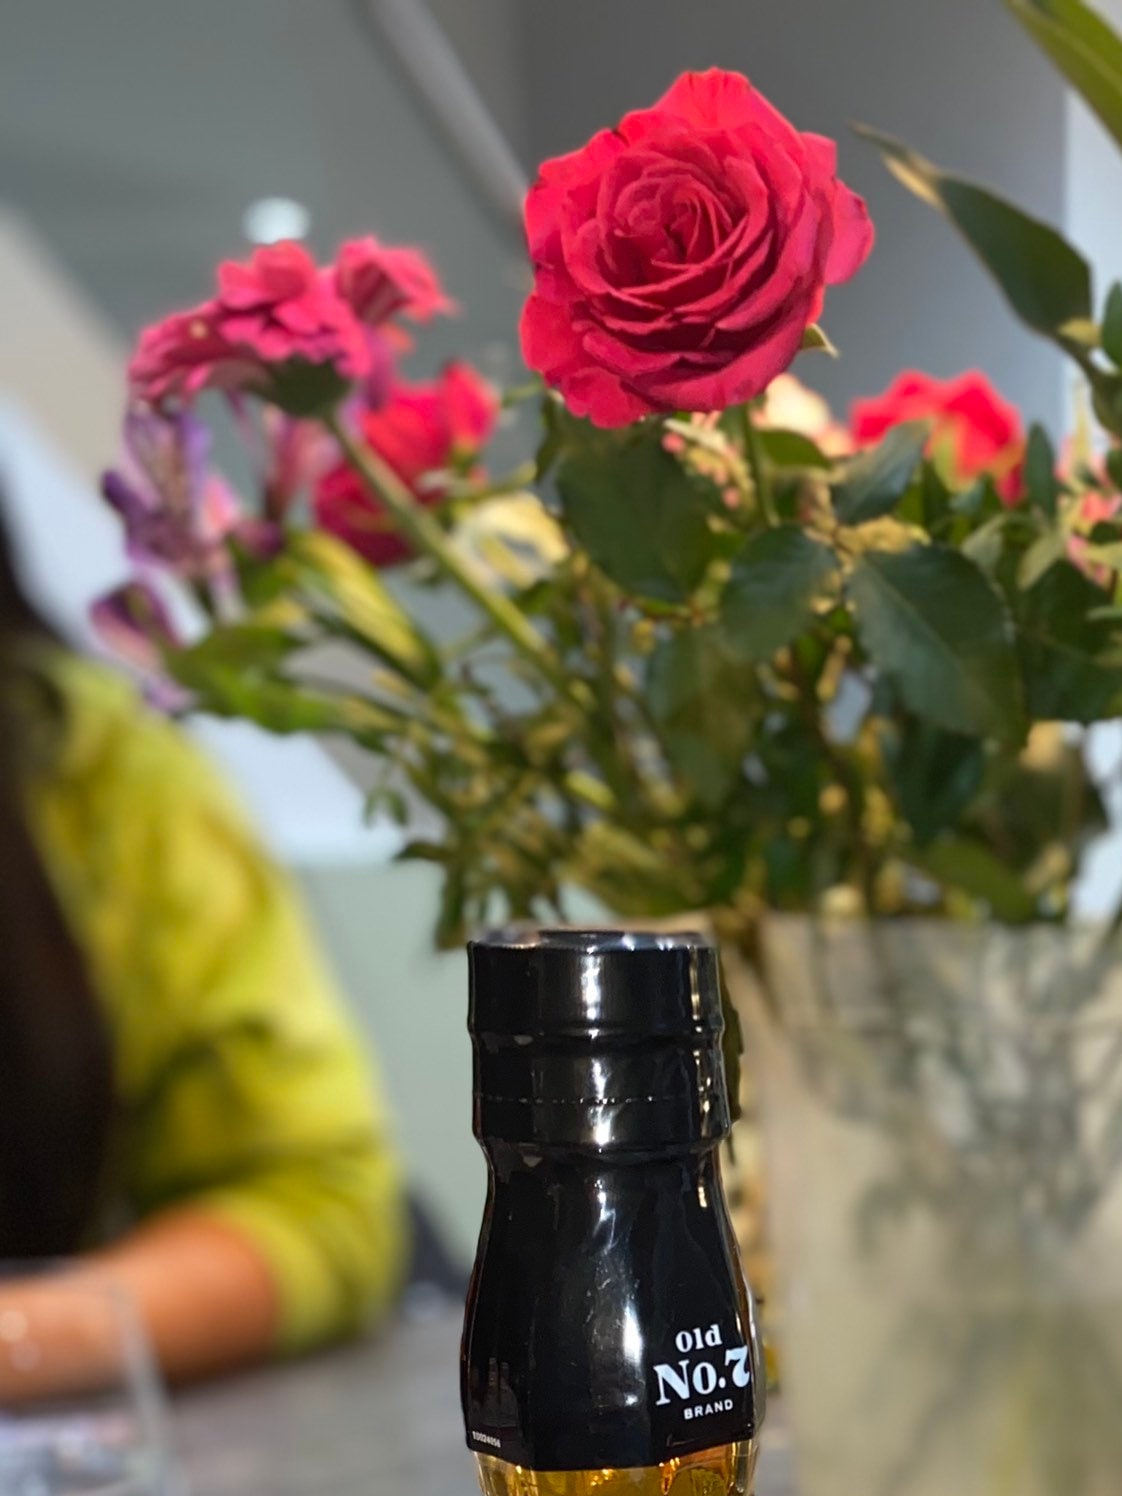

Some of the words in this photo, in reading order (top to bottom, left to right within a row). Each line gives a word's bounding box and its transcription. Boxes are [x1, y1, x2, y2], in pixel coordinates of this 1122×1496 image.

[676, 1323, 722, 1353] Old
[653, 1345, 750, 1406] No.7
[683, 1398, 733, 1421] BRAND
